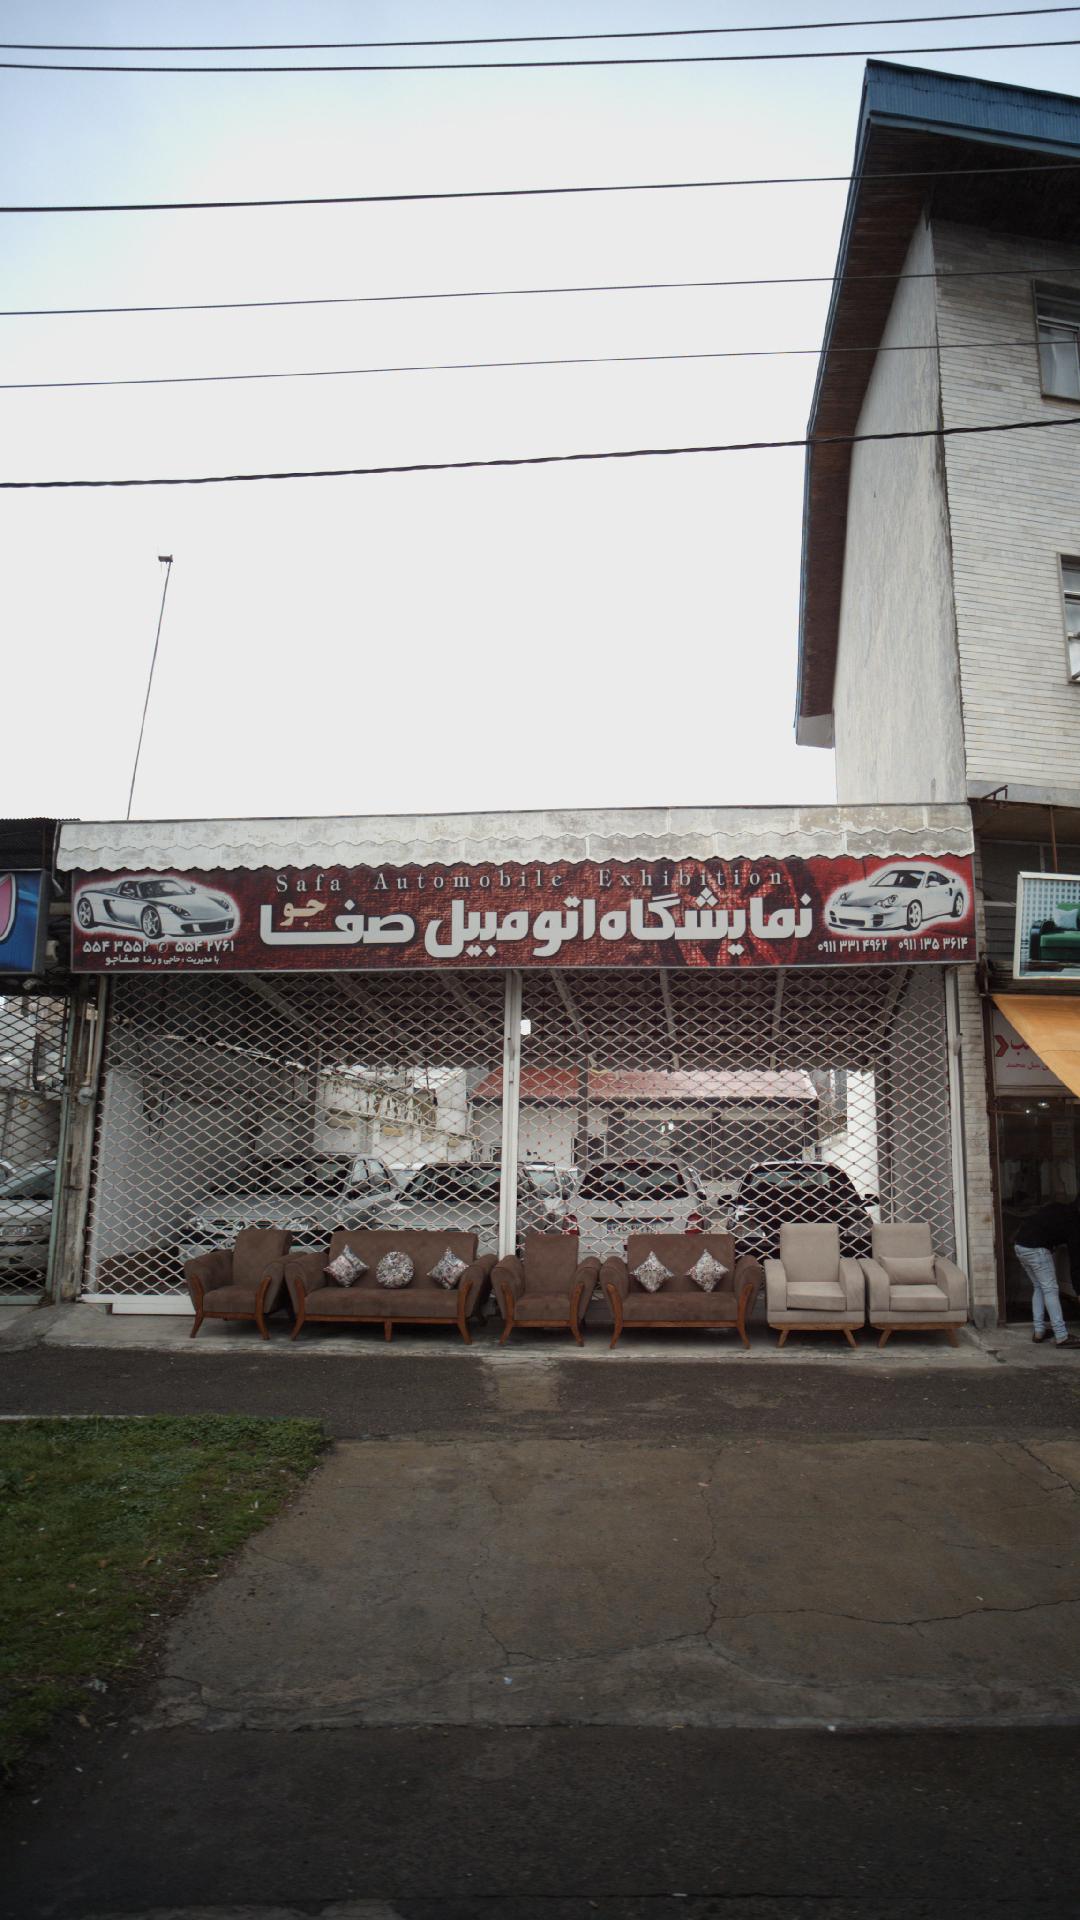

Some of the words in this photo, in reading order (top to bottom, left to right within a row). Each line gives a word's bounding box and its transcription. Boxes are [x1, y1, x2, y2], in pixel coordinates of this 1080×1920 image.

[276, 873, 341, 892] Safa
[373, 870, 562, 890] Automobile
[599, 869, 782, 887] Exhibition
[260, 899, 415, 945] صفا
[280, 899, 327, 927] جو
[424, 896, 596, 958] اتومبیل
[600, 887, 813, 956] نمایشگاه
[143, 955, 156, 965] رضا
